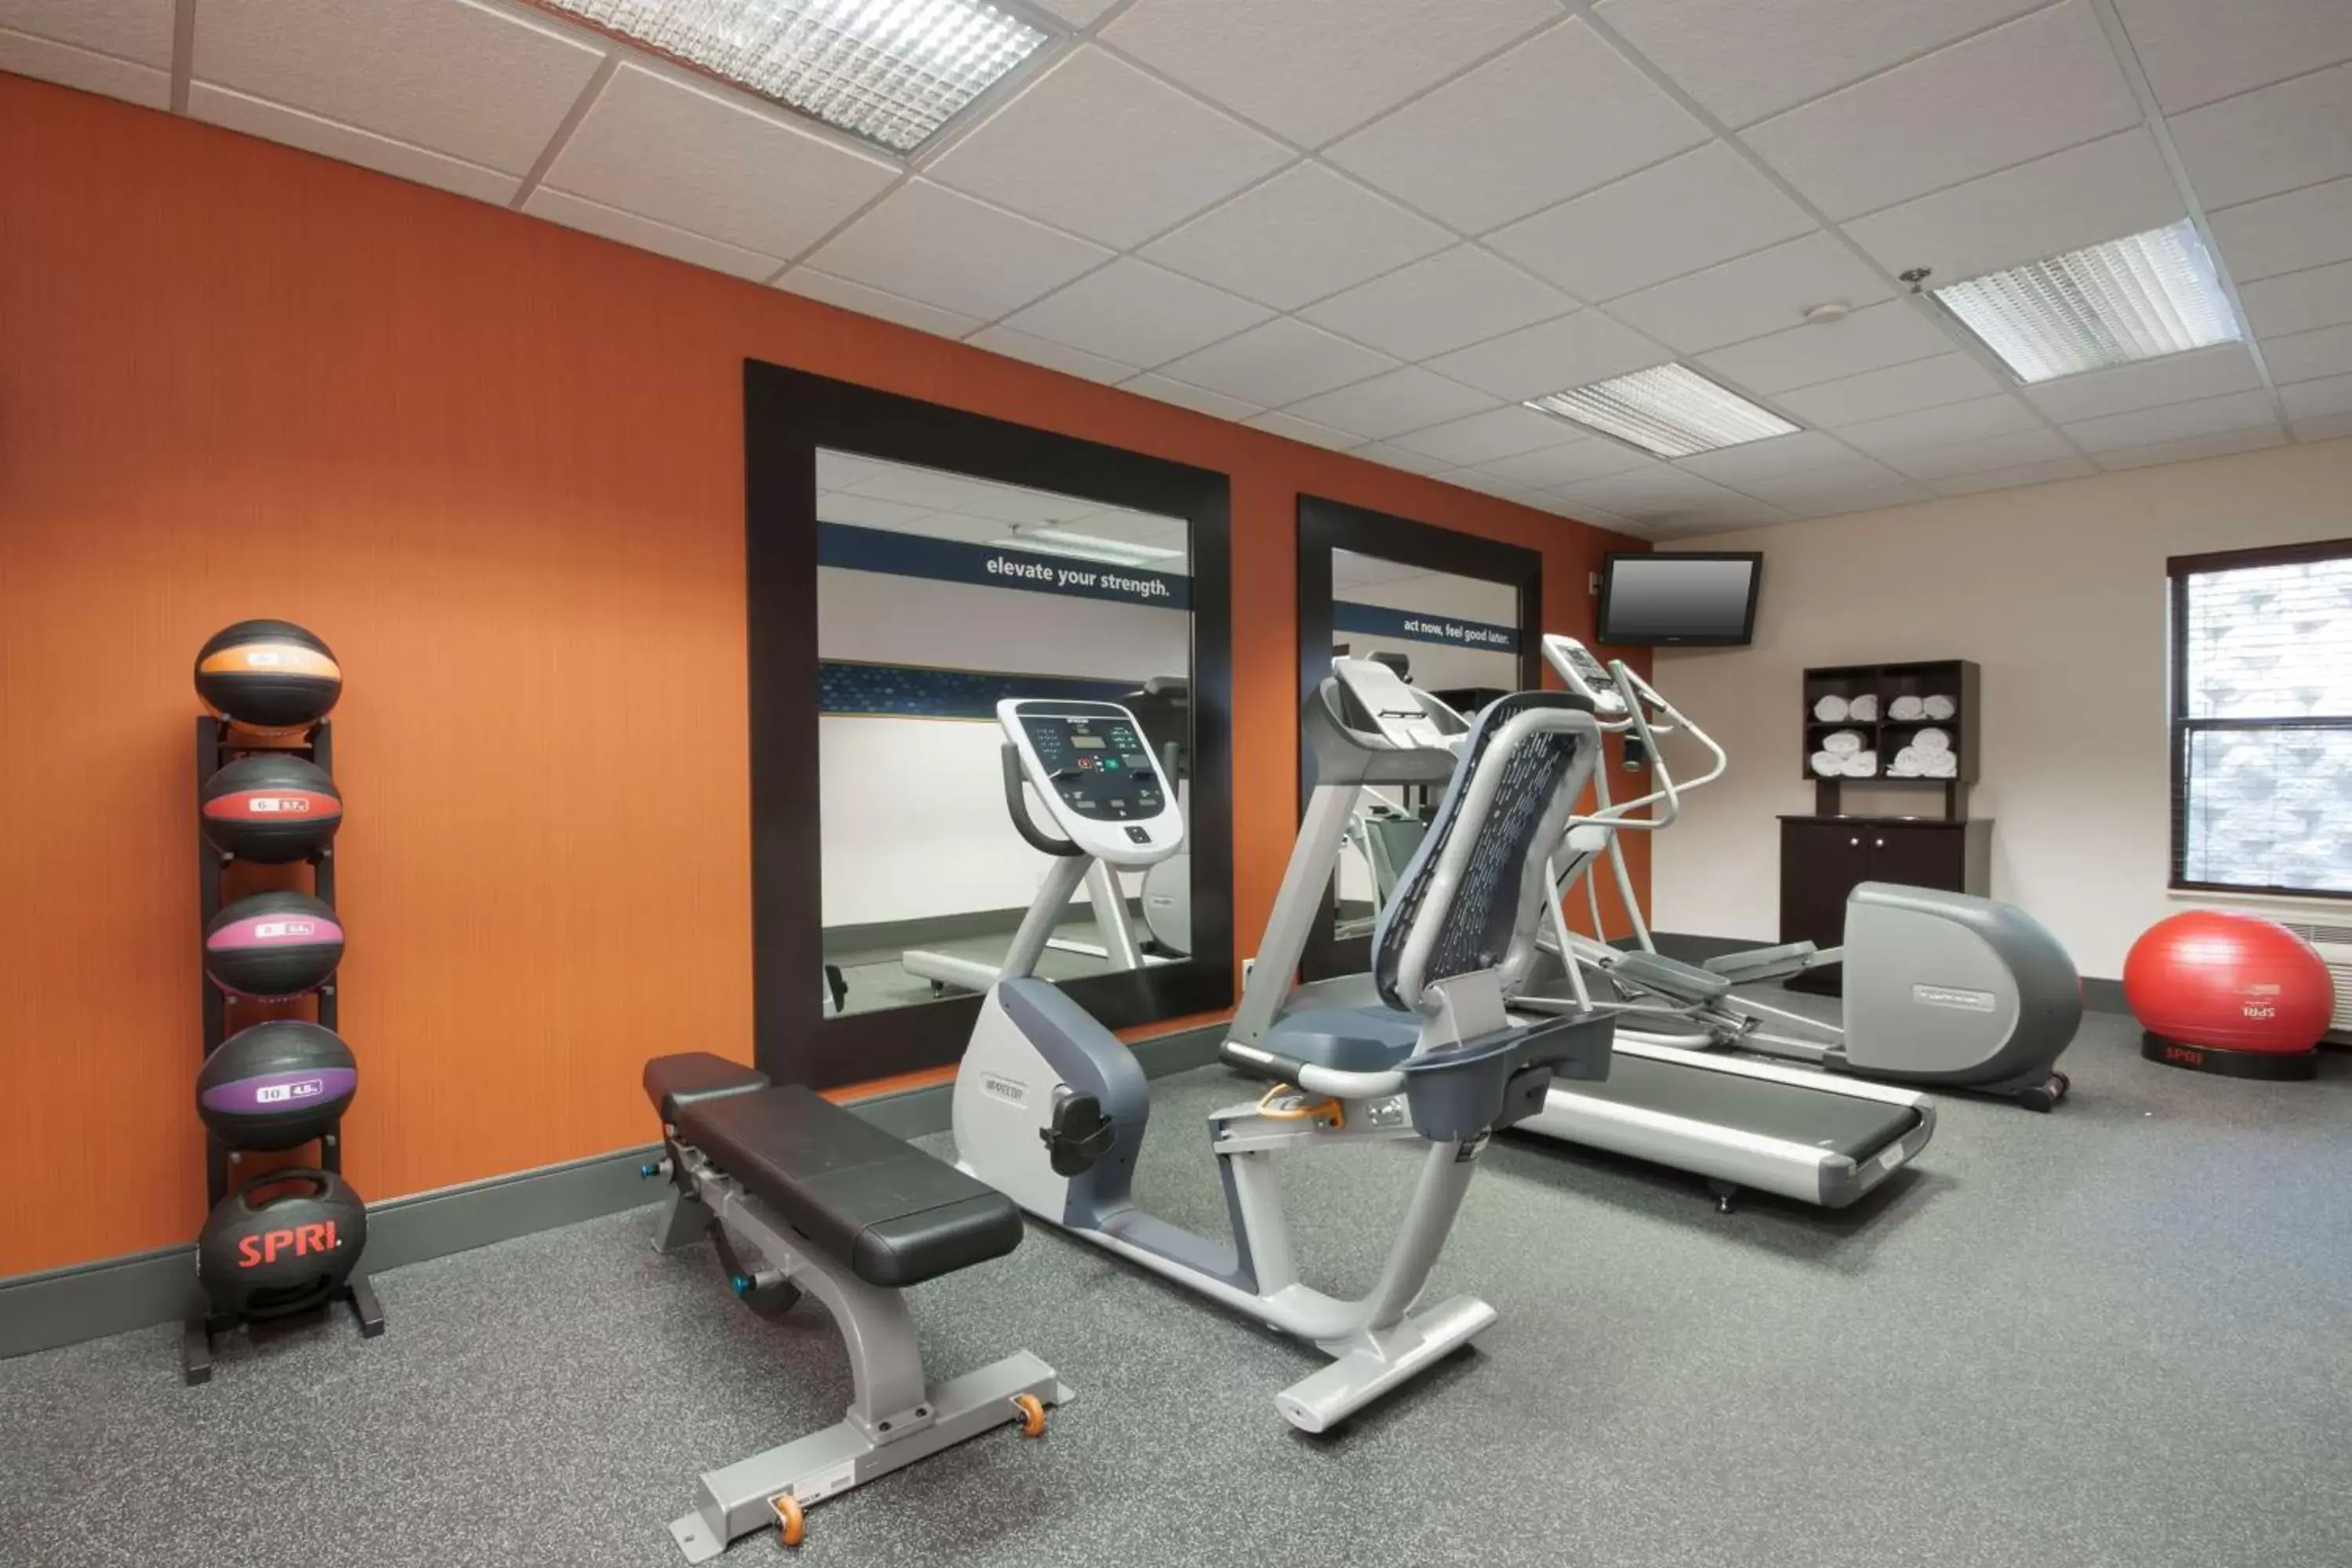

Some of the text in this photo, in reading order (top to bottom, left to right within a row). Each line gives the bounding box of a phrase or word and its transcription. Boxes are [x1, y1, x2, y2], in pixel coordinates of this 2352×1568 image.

[987, 556, 1170, 597] elevate your strength.
[1404, 620, 1419, 631] act
[1421, 622, 1443, 637] now,
[1446, 623, 1464, 637] feel
[1465, 628, 1487, 642] good
[263, 1089, 280, 1100] 10
